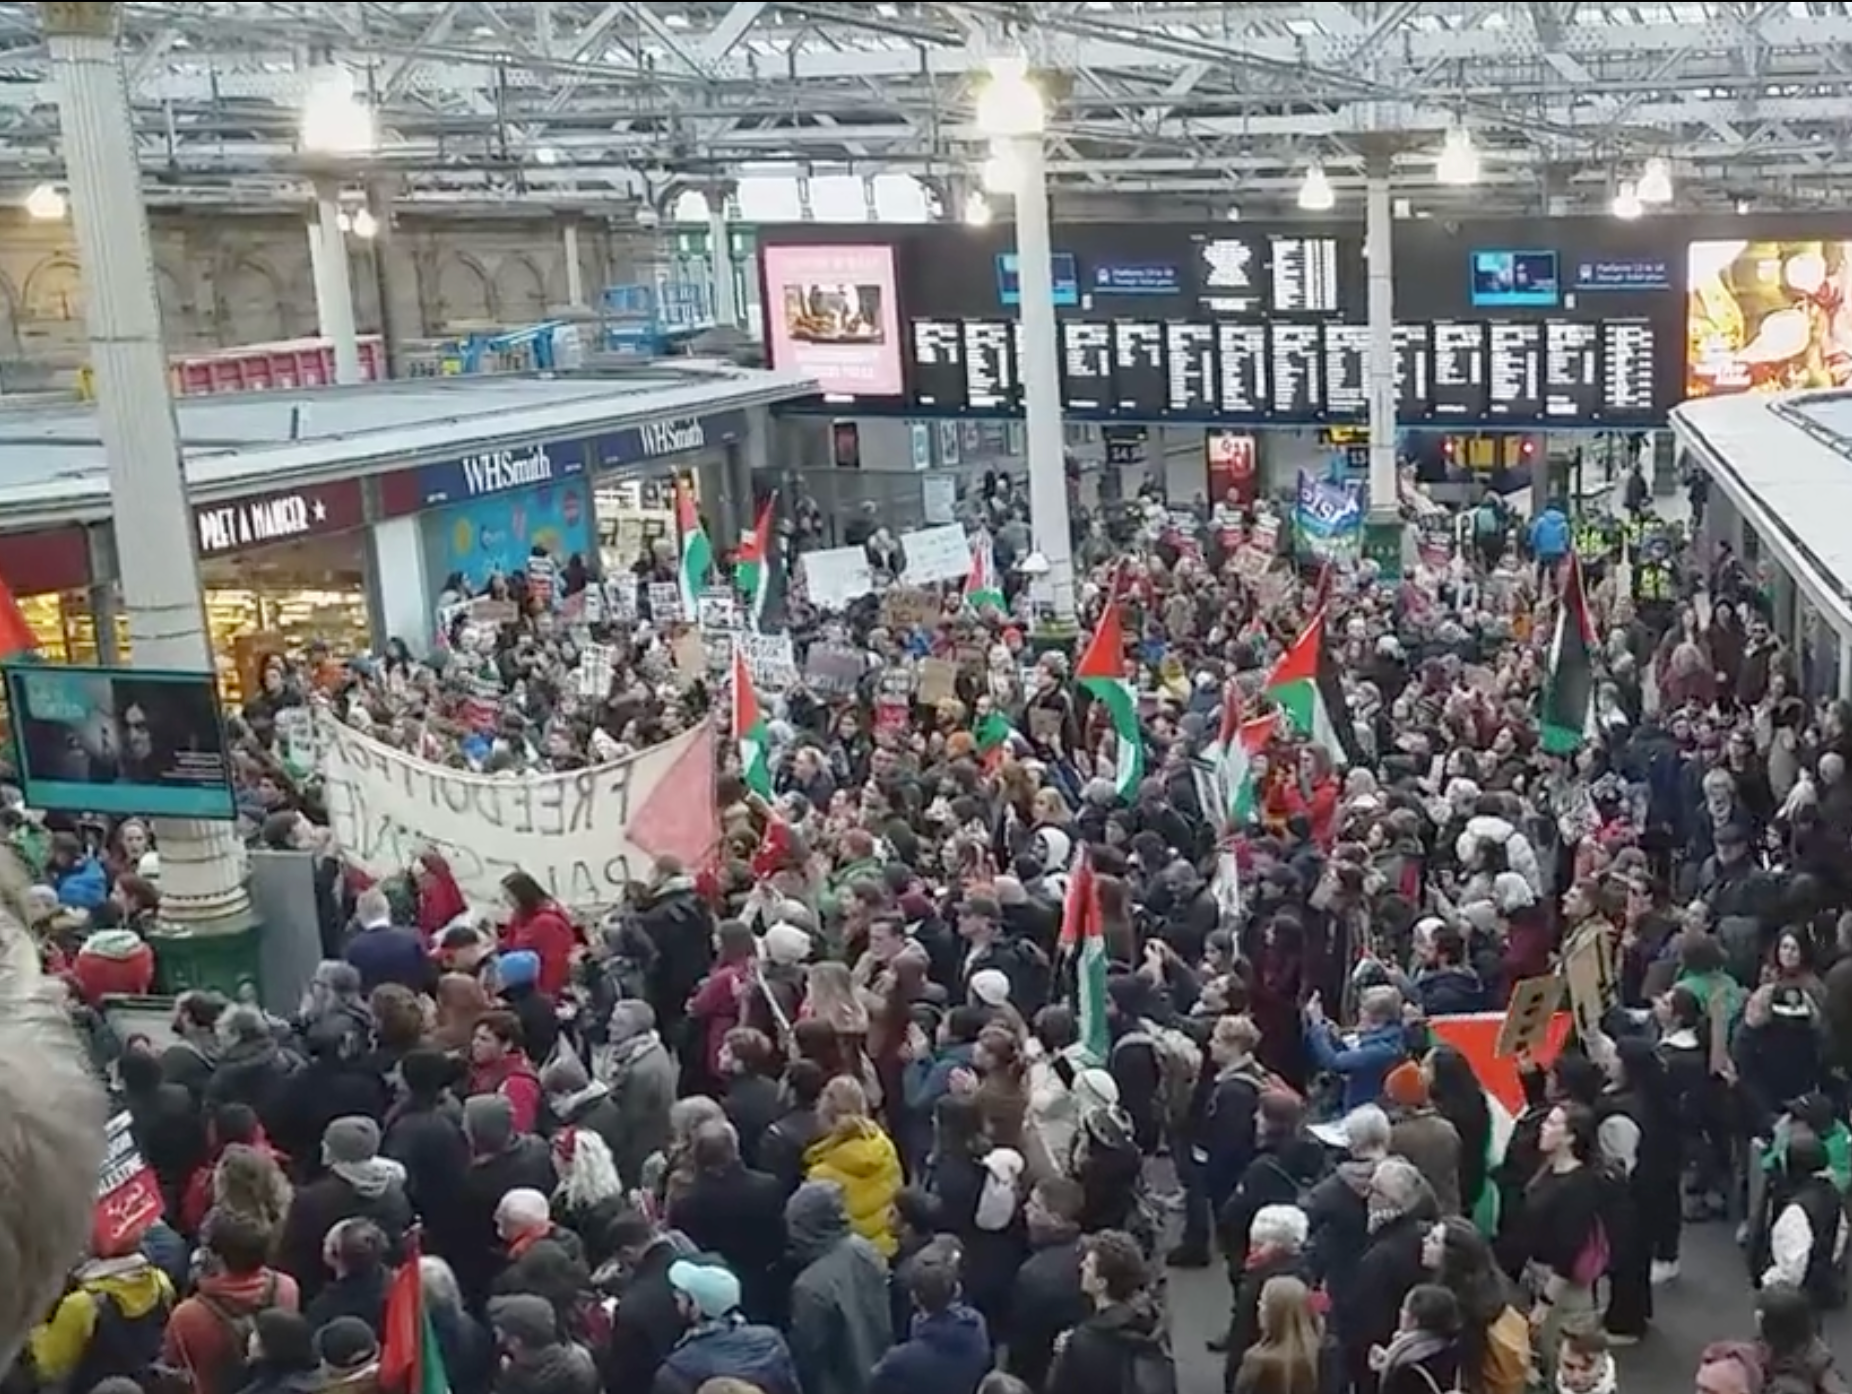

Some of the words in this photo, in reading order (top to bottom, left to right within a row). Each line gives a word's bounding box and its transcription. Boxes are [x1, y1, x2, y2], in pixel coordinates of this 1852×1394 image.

[638, 415, 705, 455] WHSmith
[462, 445, 552, 495] WHSmith
[199, 508, 238, 550] PRET
[239, 506, 252, 543] A
